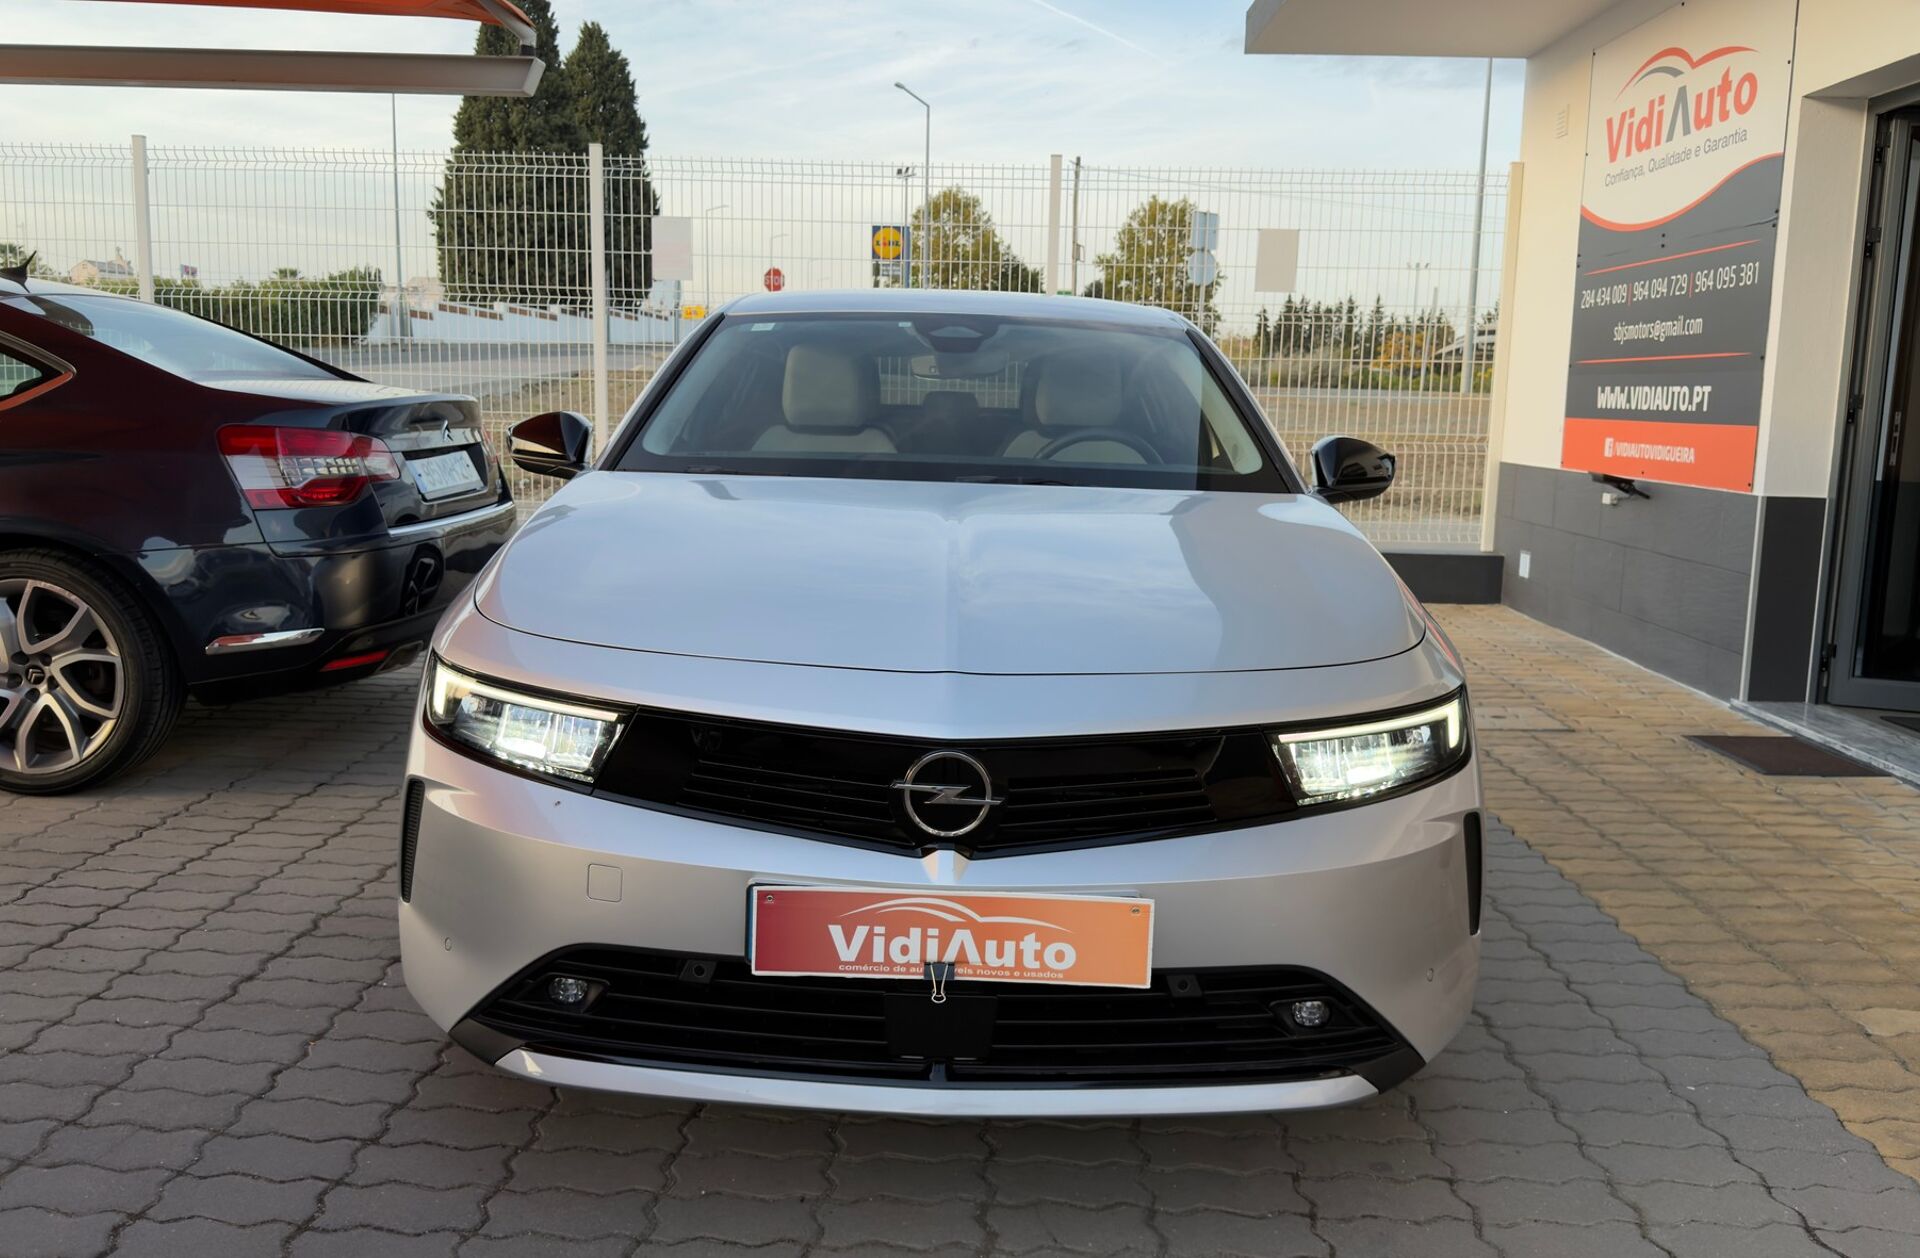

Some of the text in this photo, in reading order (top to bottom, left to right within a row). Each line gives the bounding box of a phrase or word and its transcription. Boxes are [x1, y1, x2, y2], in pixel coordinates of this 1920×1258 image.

[1606, 66, 1758, 163] VidiAuto
[1605, 128, 1748, 187] Confiança, Qualidade e Garantia
[1581, 261, 1760, 309] 284 434 009 964 094 729 964 095 381
[1613, 315, 1703, 345] sbjsmotors@gmail.com
[1597, 385, 1712, 412] WWW.VIDIAUTO.PT
[828, 924, 1077, 970] VidiAuto
[839, 964, 890, 973] comércio
[893, 965, 907, 973] de
[976, 970, 1010, 978] novos
[1023, 971, 1064, 979] usados
